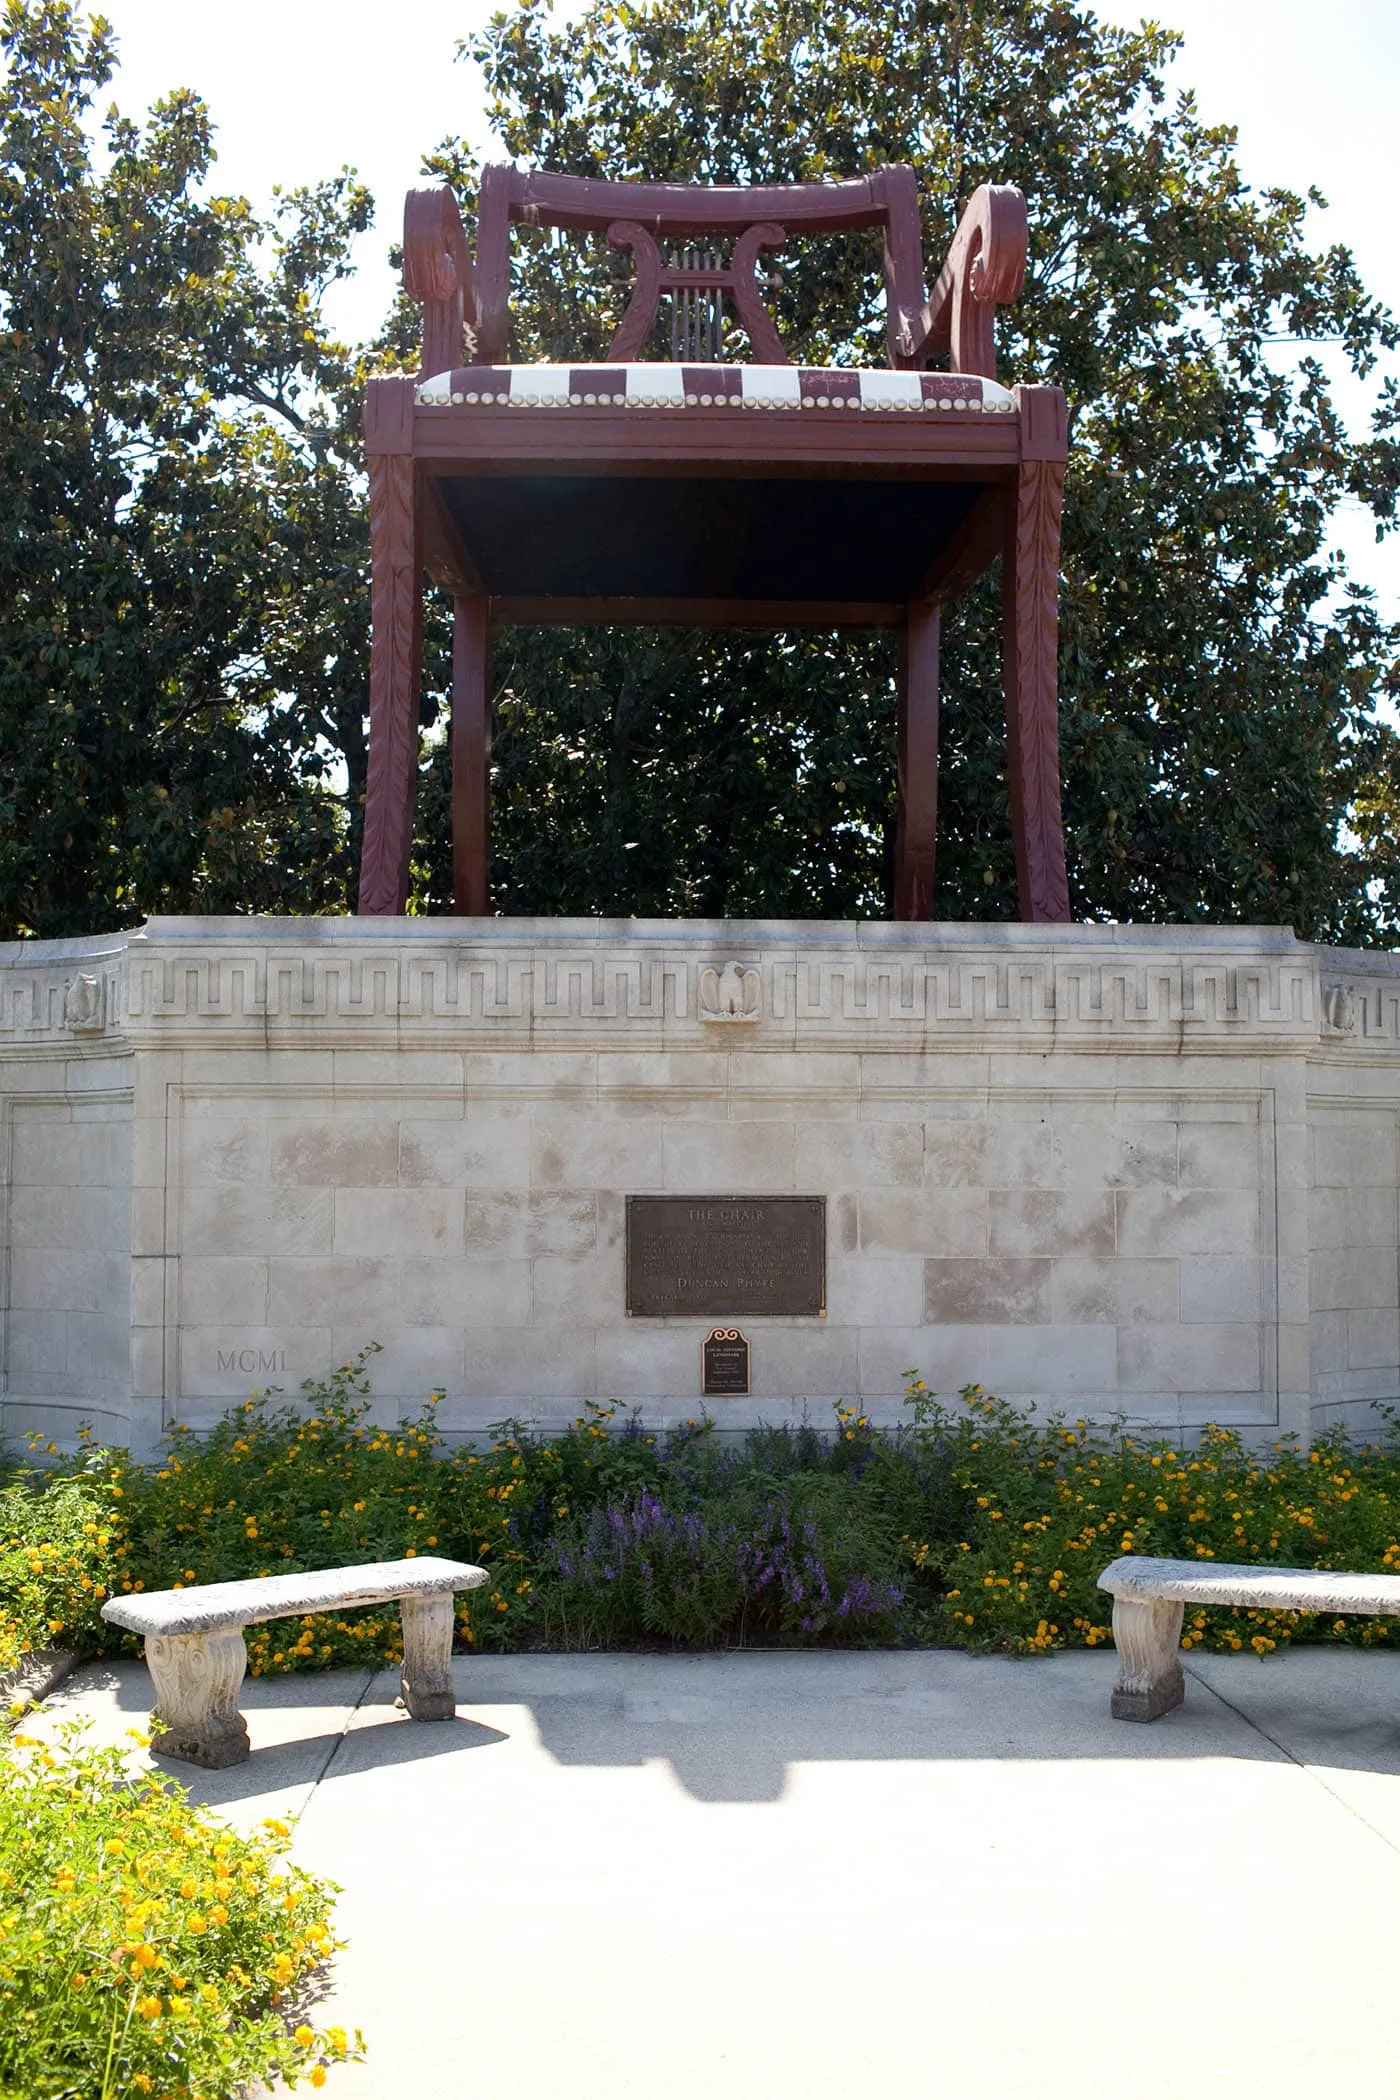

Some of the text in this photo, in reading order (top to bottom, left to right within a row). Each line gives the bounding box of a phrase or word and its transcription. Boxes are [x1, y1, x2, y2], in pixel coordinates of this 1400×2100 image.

[688, 1208, 765, 1221] THE CHAIR
[677, 1278, 729, 1289] DUNCAN
